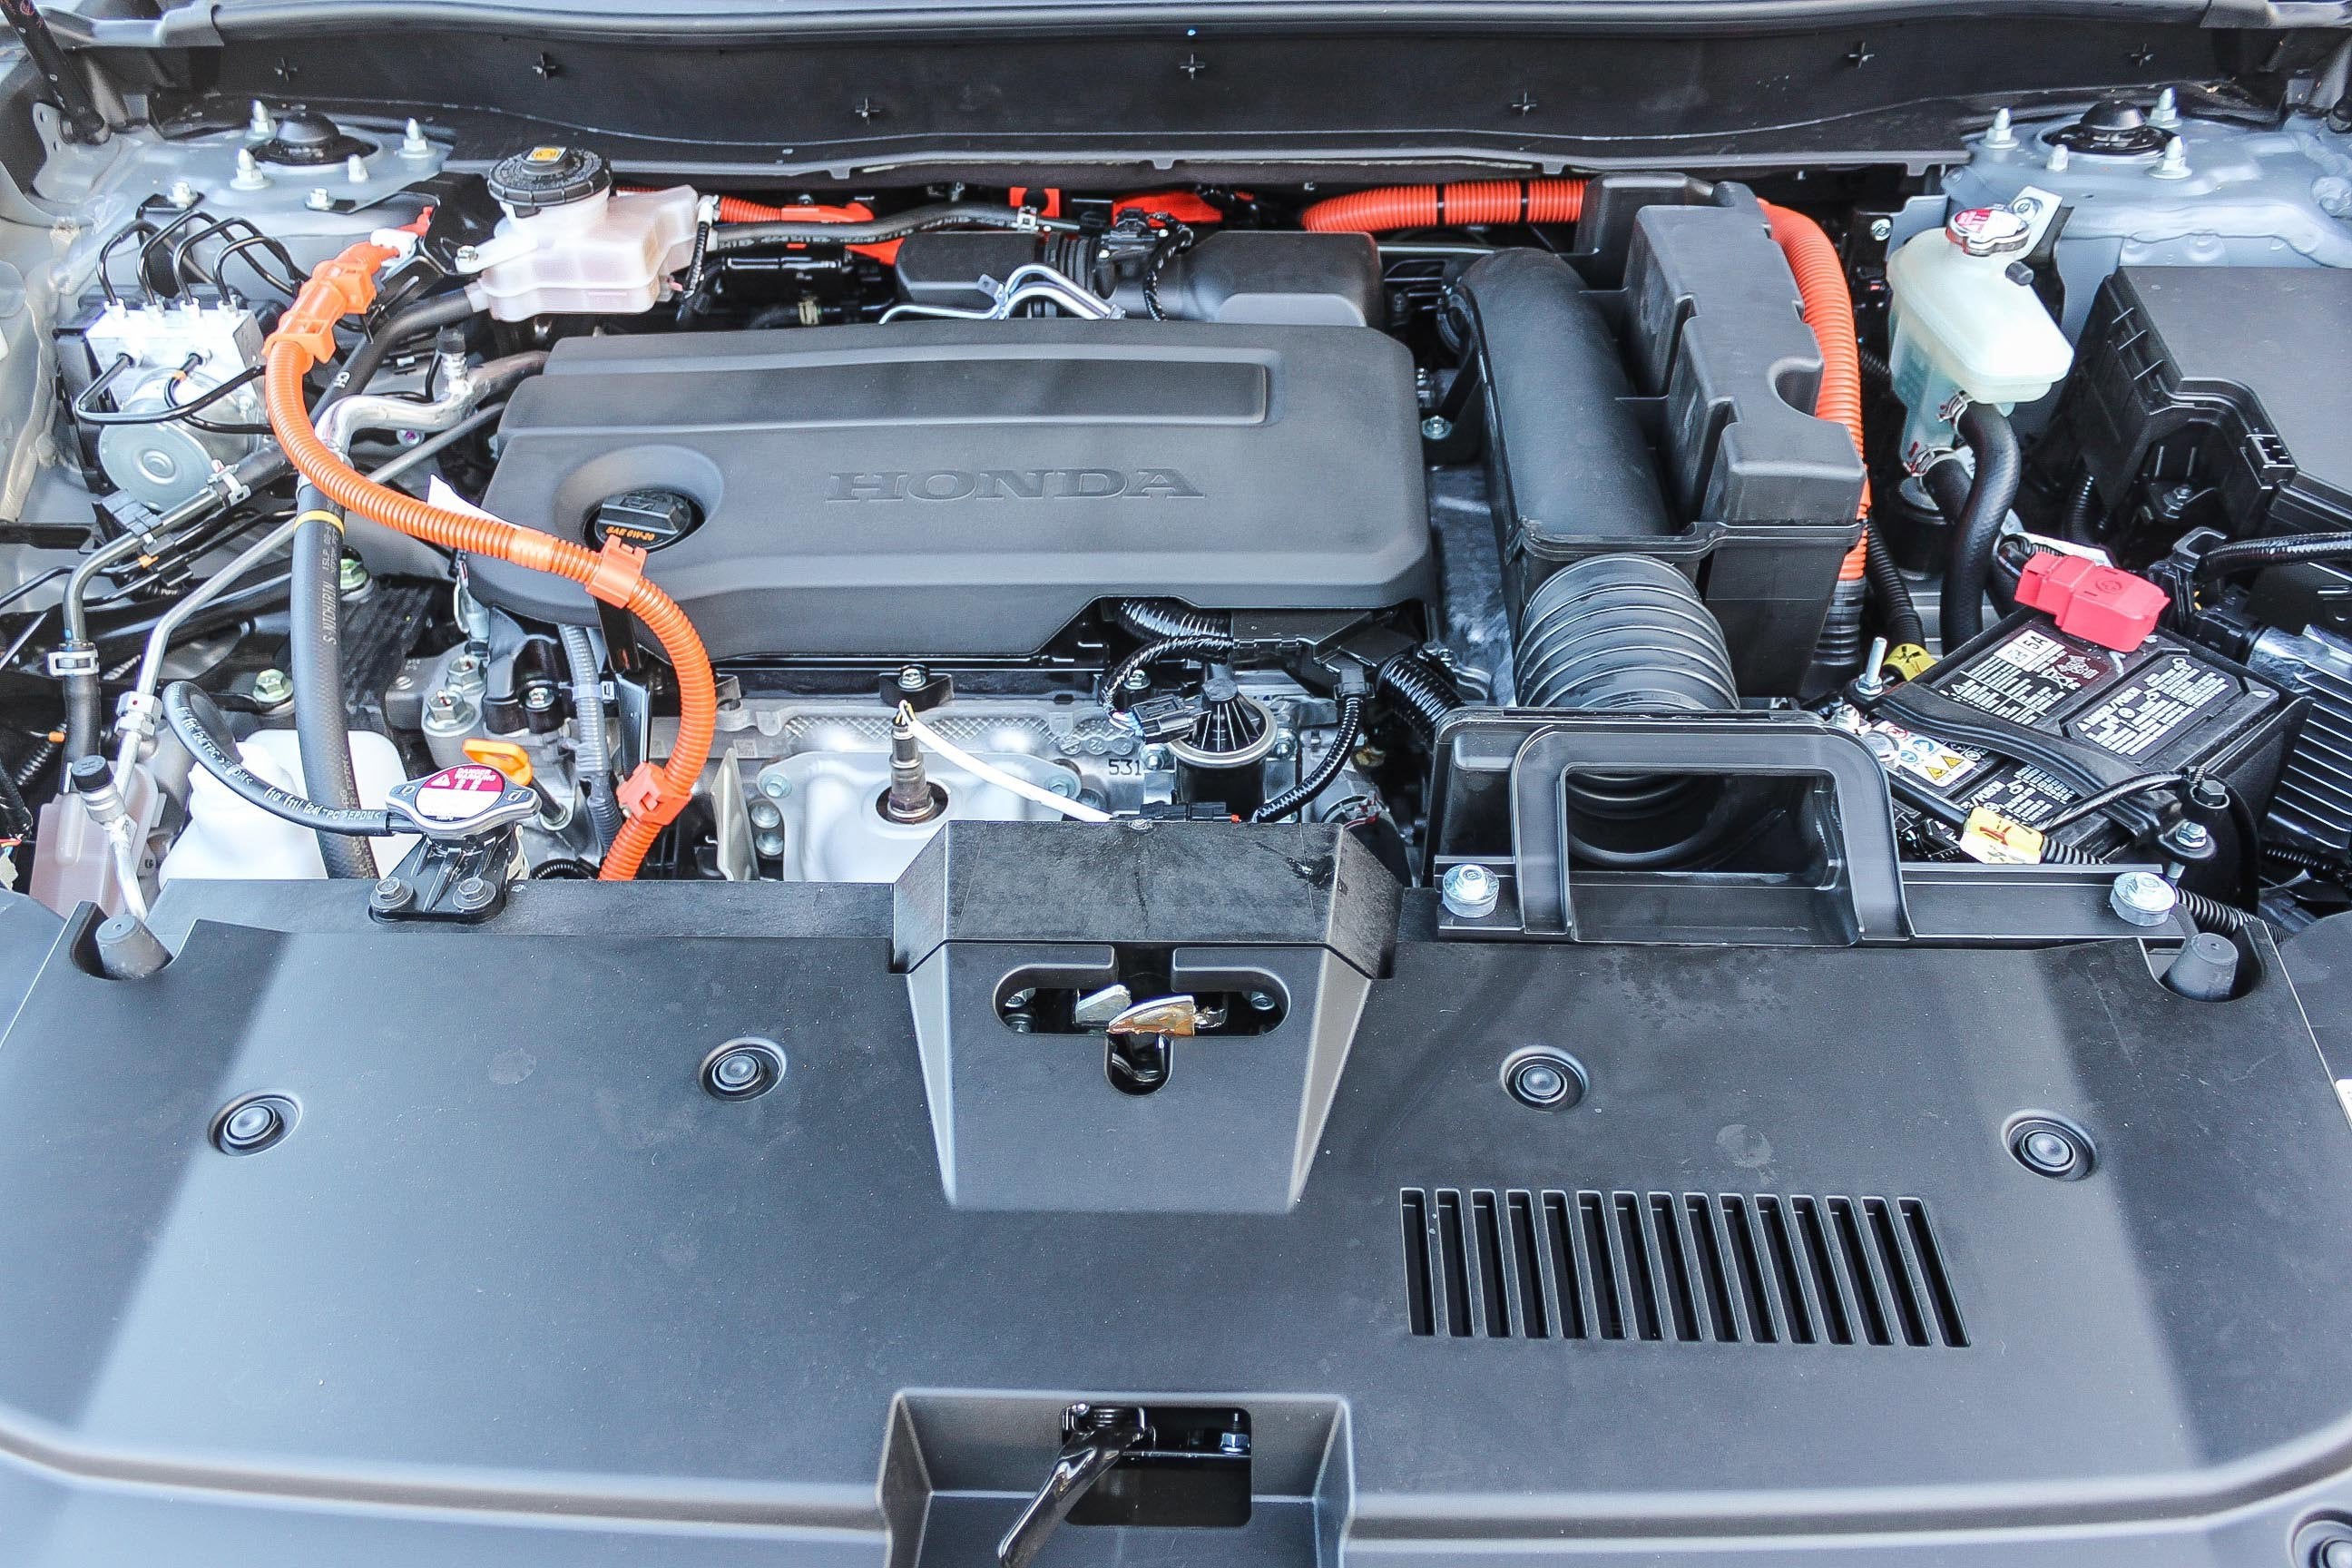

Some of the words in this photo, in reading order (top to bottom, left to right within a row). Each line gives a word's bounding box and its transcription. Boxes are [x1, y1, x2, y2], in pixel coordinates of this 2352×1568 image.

[824, 467, 1207, 503] HONDA
[2024, 635, 2049, 651] 5A
[1108, 758, 1142, 776] 531
